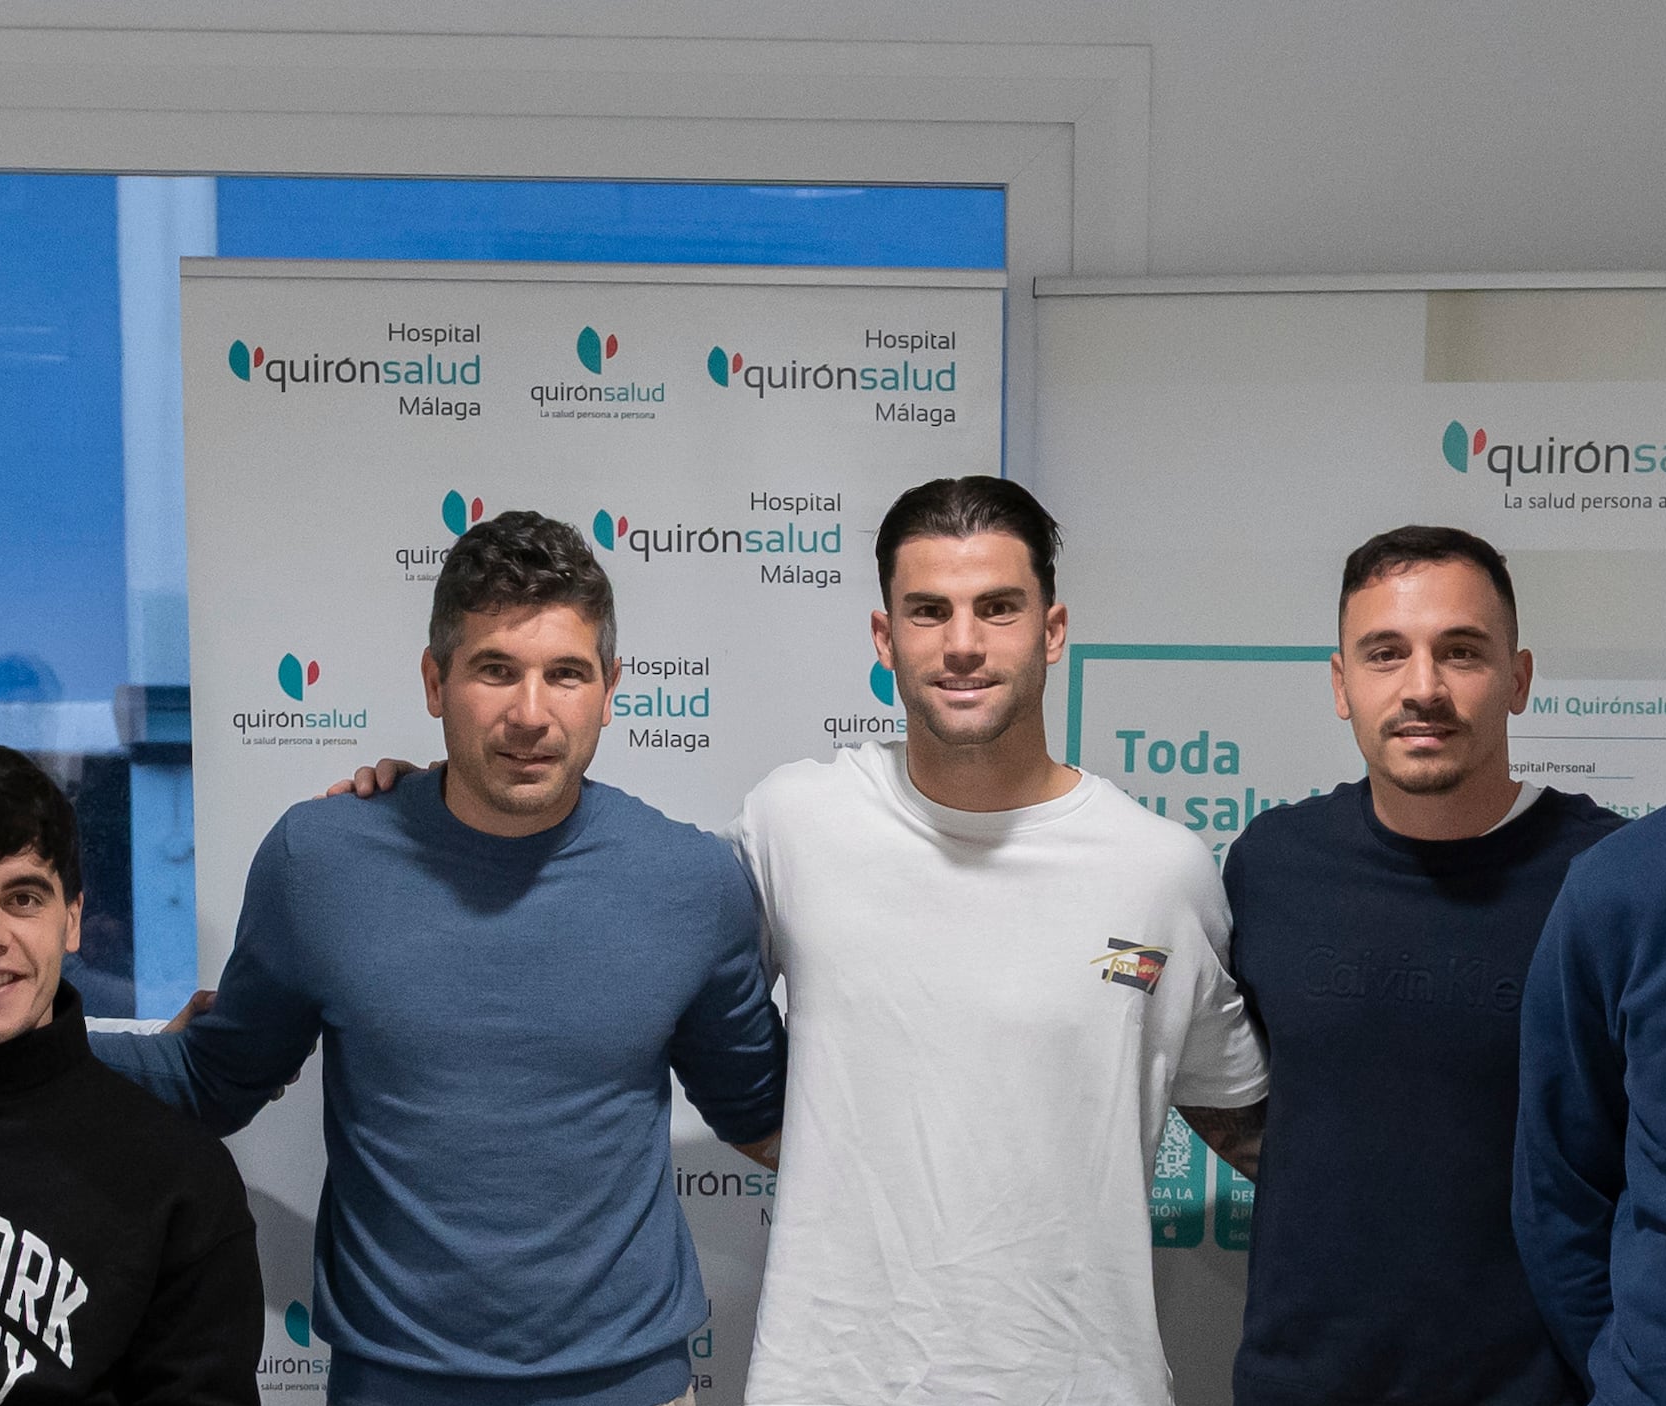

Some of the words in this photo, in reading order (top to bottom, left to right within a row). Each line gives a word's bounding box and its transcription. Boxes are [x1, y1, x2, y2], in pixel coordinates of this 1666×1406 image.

[387, 323, 481, 348] Hospital
[865, 329, 956, 354] Hospital
[265, 353, 481, 393] quirónsalud
[744, 361, 957, 399] quirónsalud
[530, 382, 665, 407] quirónsalud
[399, 396, 481, 420] Málaga
[540, 410, 549, 418] La
[552, 410, 574, 418] salud
[577, 411, 611, 419] persona
[875, 402, 956, 426] Málaga
[750, 492, 841, 516] Hospital
[1504, 492, 1523, 511] La
[1528, 491, 1575, 511] salud
[1581, 496, 1653, 514] persona
[629, 522, 841, 562] quirónsalud
[760, 563, 841, 588] Málaga
[620, 656, 709, 679] Hospital
[1533, 697, 1558, 714] Mi
[233, 709, 367, 735] quirónsalud
[824, 714, 907, 738] quiróns
[242, 737, 251, 745] La
[253, 737, 276, 745] salud
[278, 738, 313, 746] persona
[322, 738, 357, 746] persona
[629, 729, 709, 752] Málaga
[1115, 730, 1240, 775] Toda
